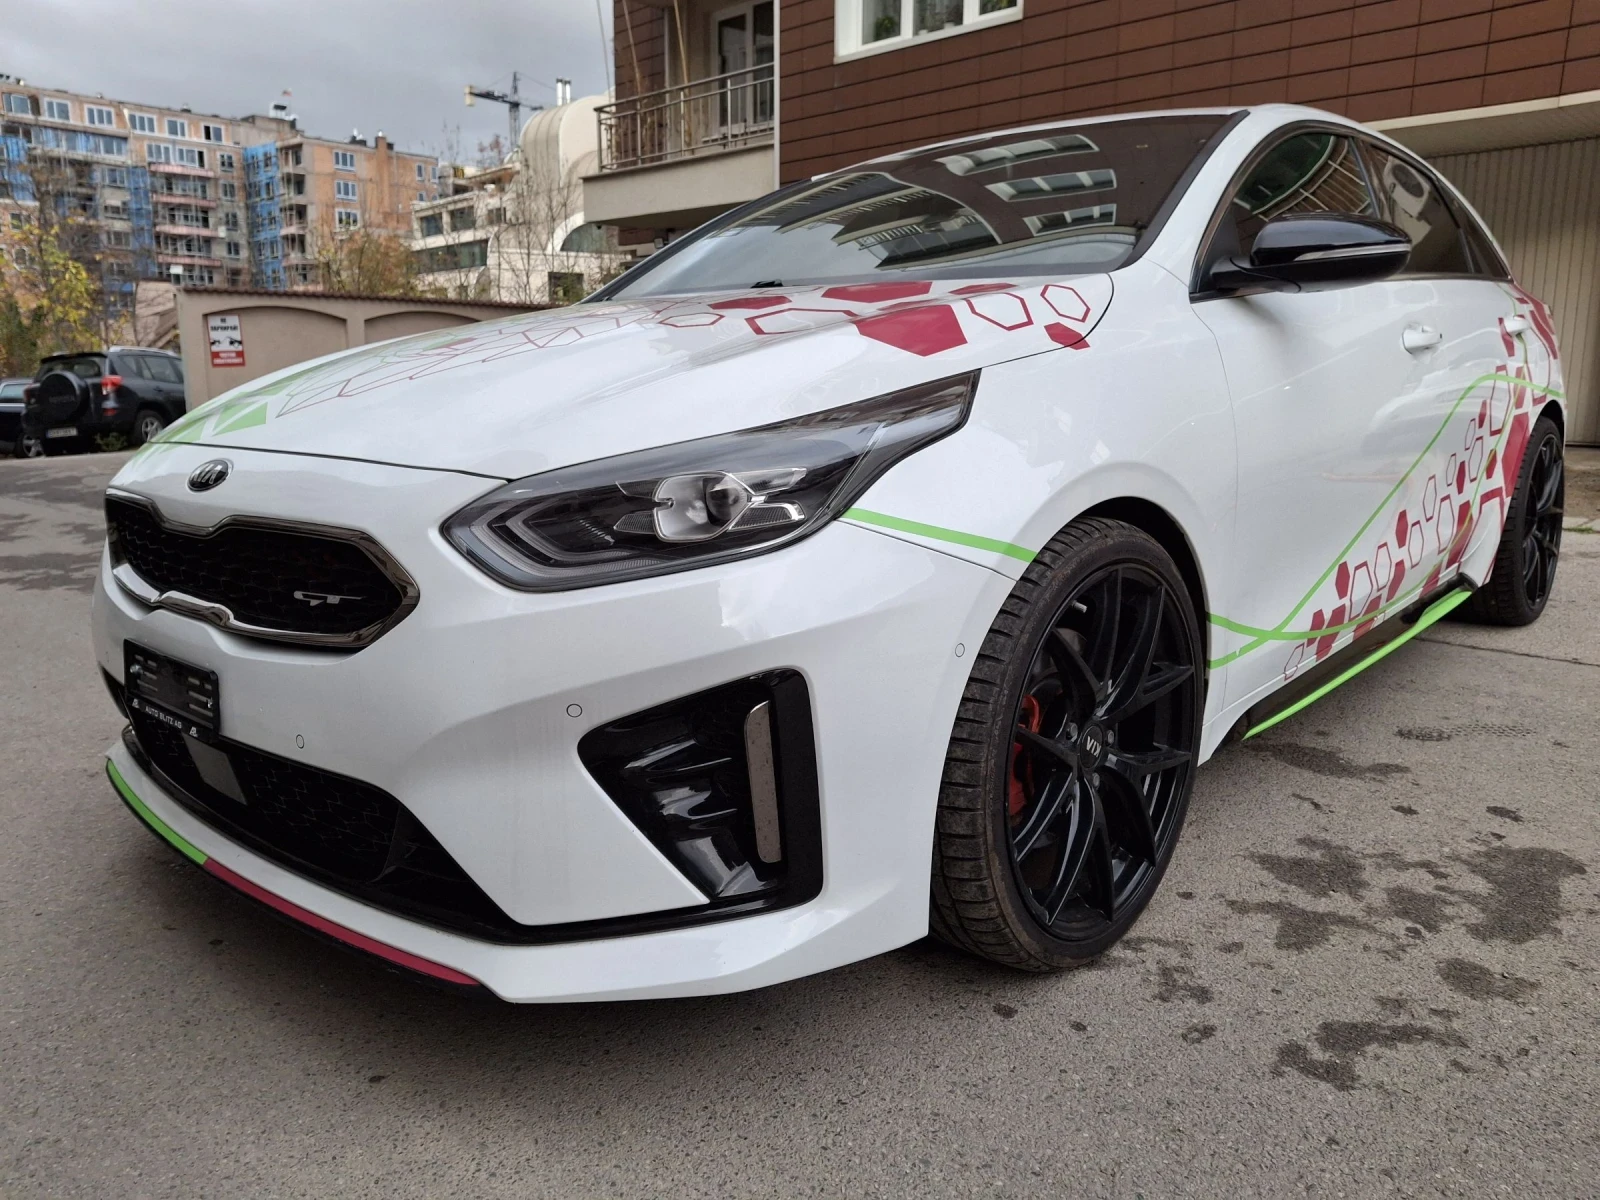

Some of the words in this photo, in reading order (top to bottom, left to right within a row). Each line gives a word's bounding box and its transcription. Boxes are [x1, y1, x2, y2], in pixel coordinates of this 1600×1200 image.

[190, 463, 223, 485] KIA
[145, 705, 158, 718] AUTO
[159, 712, 174, 725] BLITZ
[174, 719, 182, 729] AG
[1086, 735, 1102, 758] KIA
